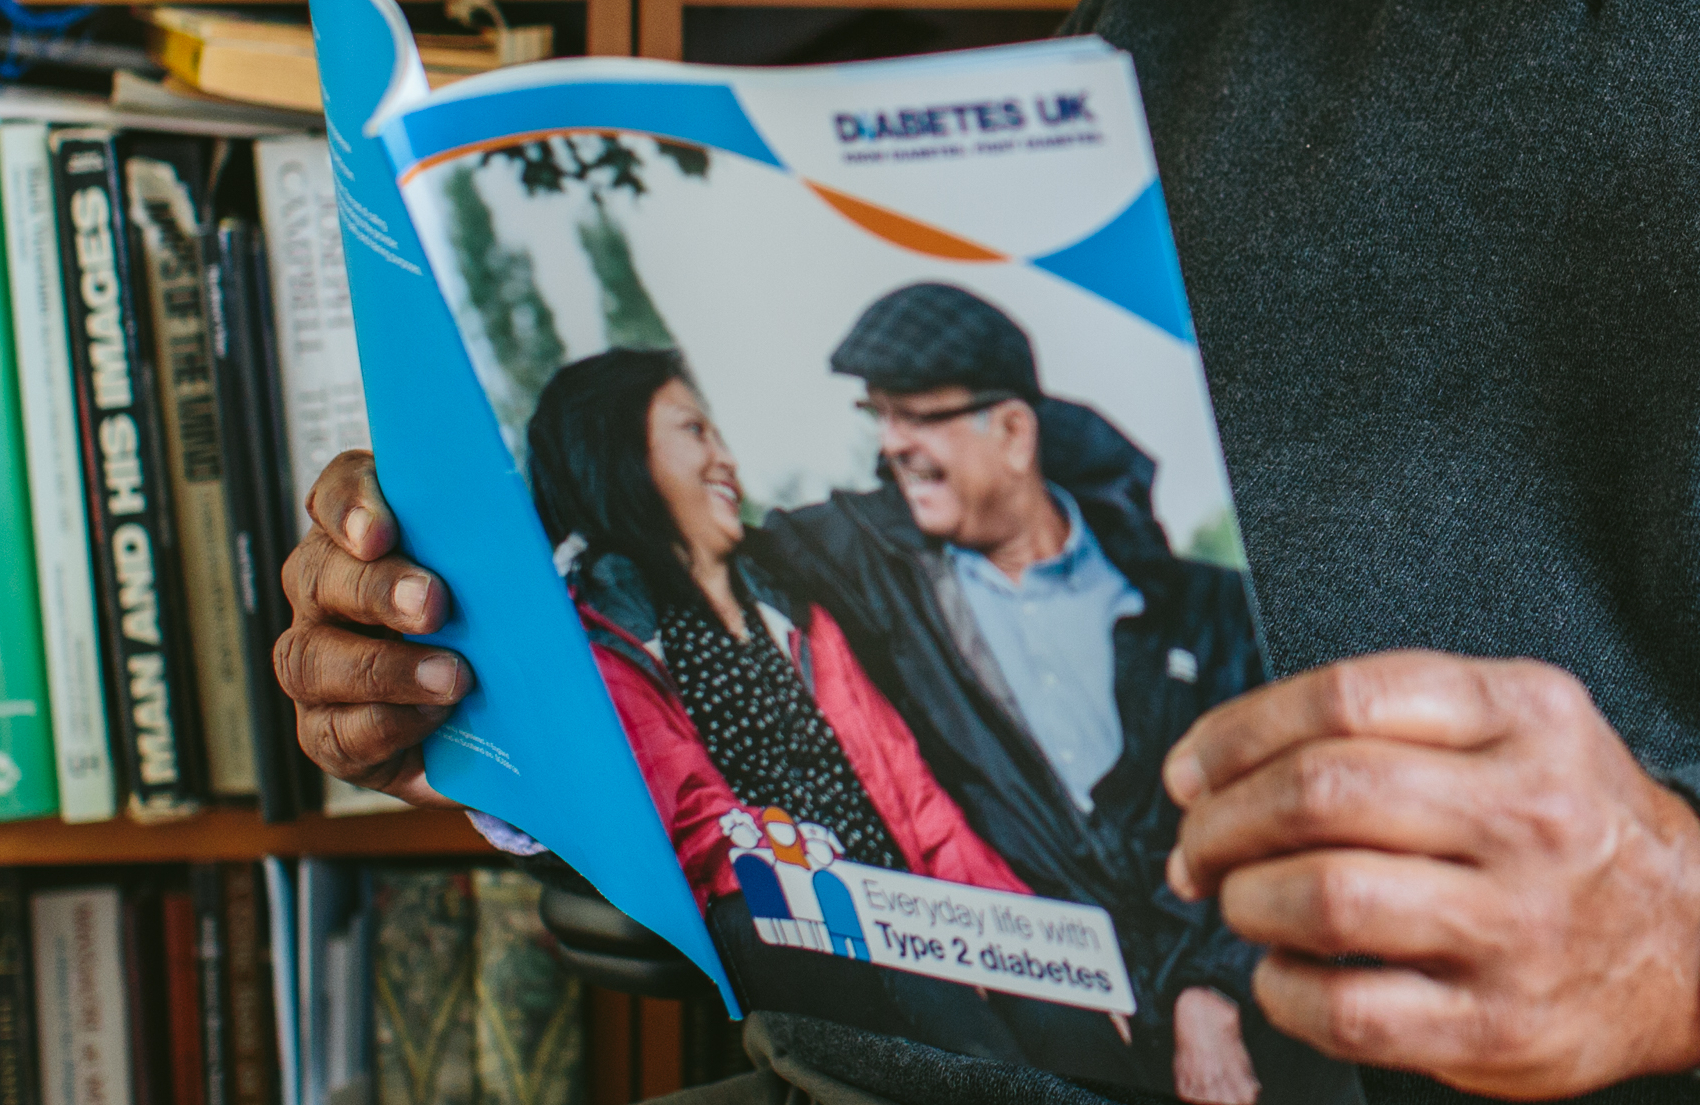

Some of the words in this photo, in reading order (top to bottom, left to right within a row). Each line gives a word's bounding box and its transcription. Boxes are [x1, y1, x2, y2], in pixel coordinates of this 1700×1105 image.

[1035, 90, 1101, 128] UK
[70, 185, 134, 410] IMAGES
[172, 329, 212, 384] THE
[98, 413, 148, 515] HIS
[111, 521, 163, 645] AND
[126, 652, 178, 785] MAN
[863, 877, 986, 937] Everyday
[989, 904, 1034, 941] life
[1038, 913, 1102, 954] with
[874, 918, 948, 963] Type
[952, 935, 976, 967] 2
[979, 941, 1115, 994] diabetes
